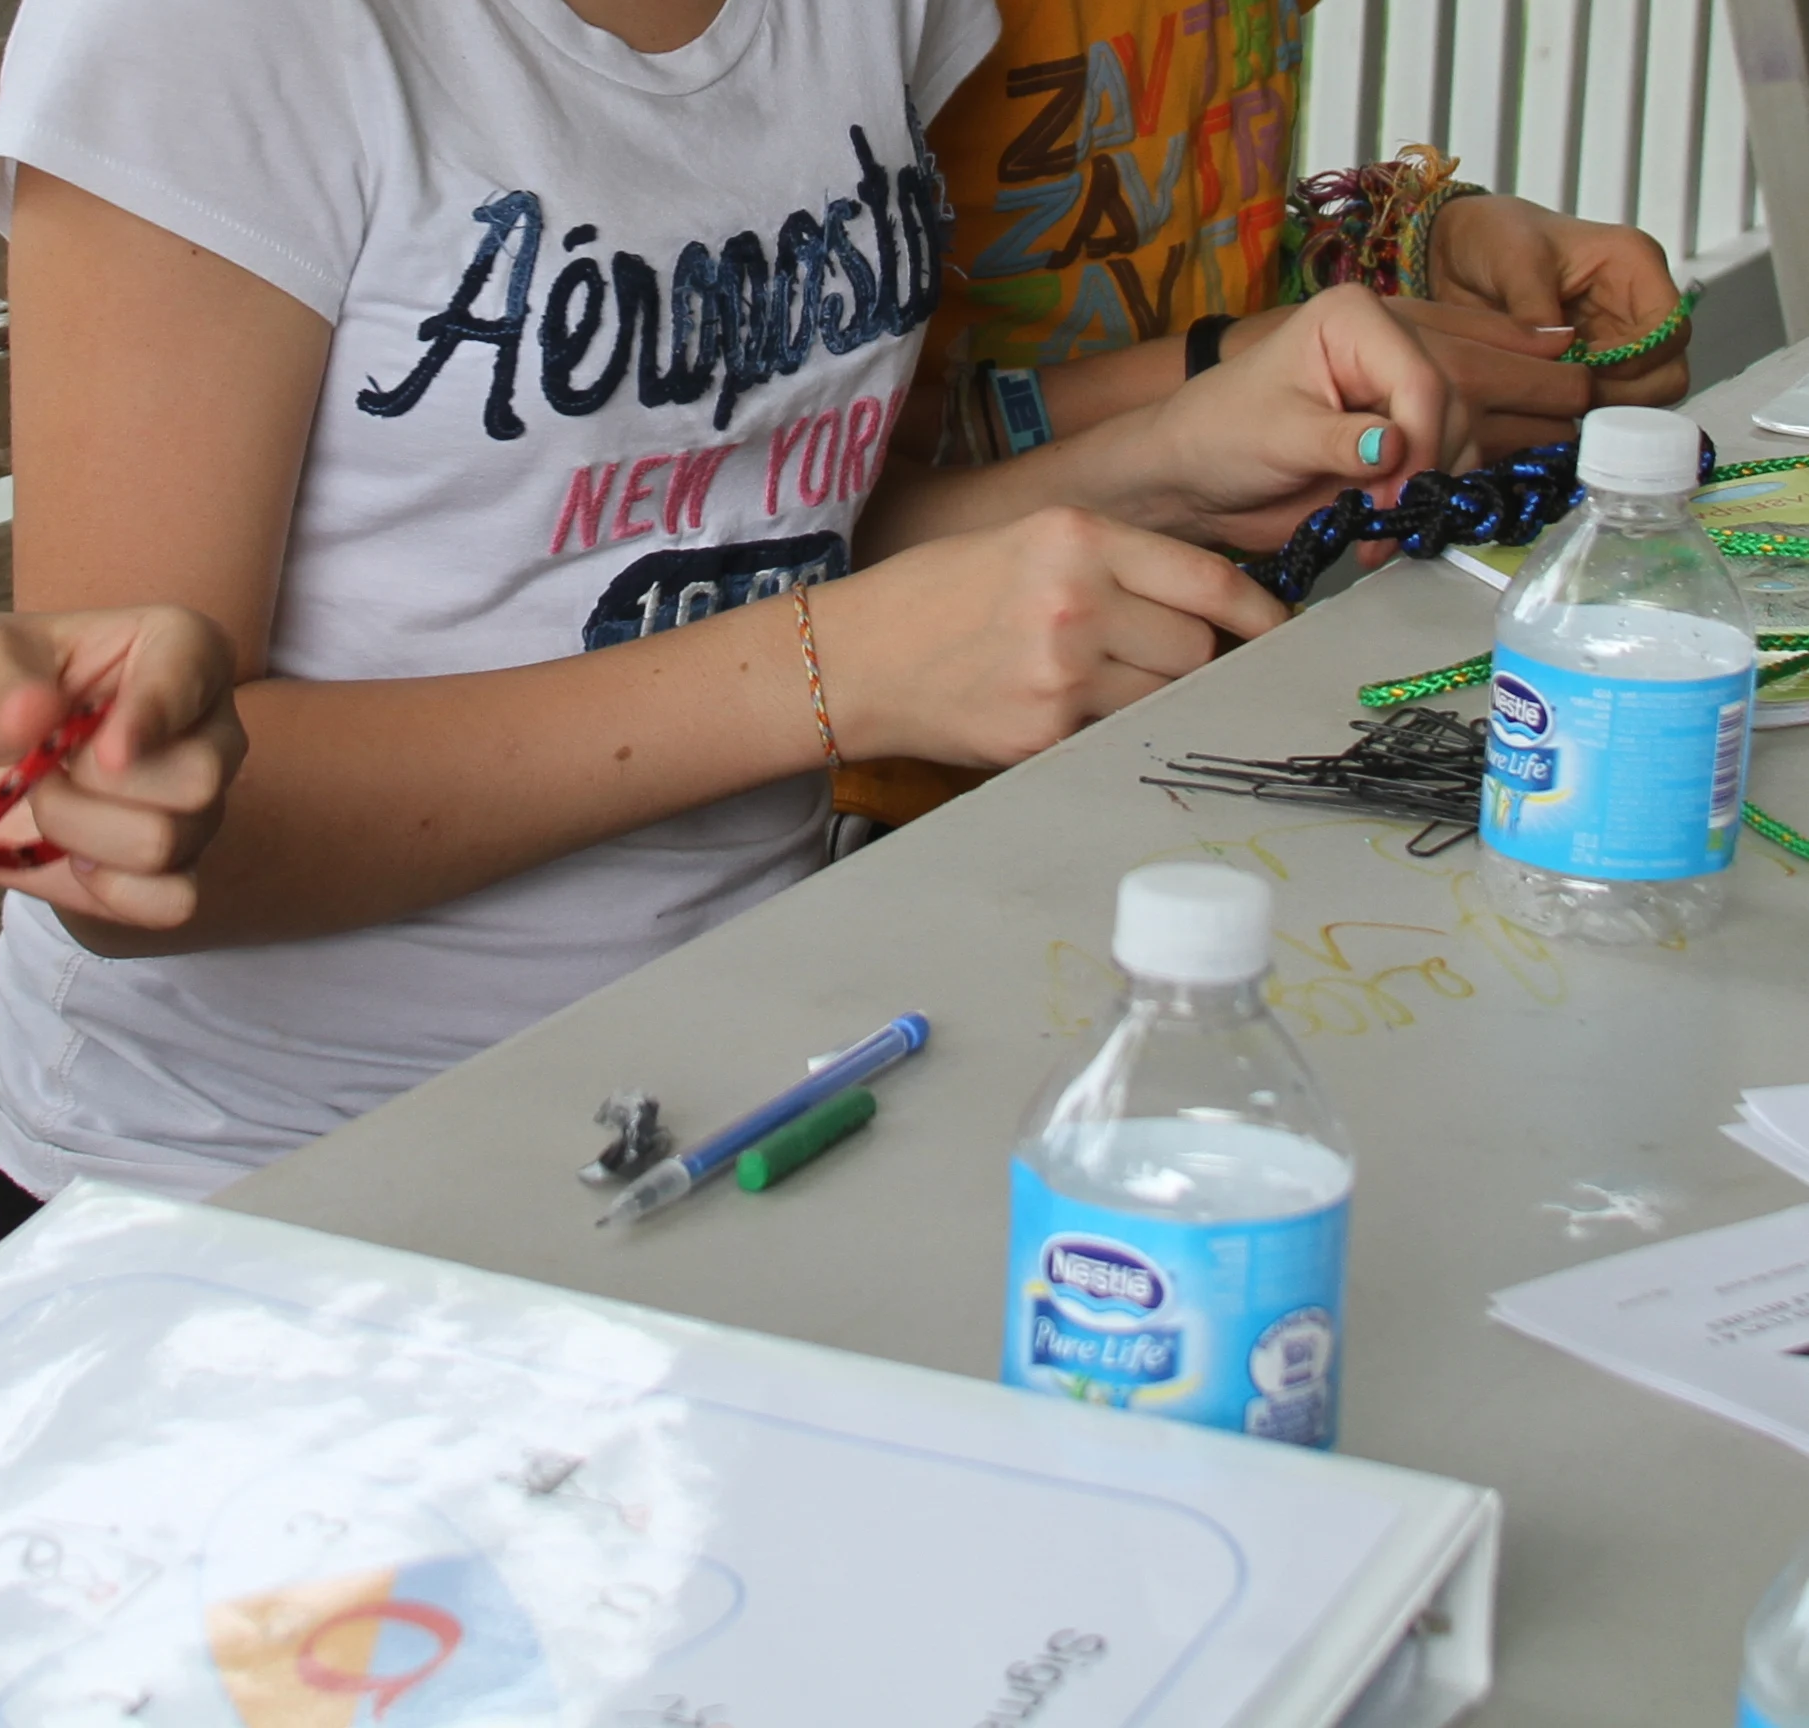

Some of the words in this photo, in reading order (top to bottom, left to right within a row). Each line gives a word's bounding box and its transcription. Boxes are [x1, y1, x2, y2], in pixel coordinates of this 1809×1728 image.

[972, 88, 1300, 278] ZAVTR
[548, 441, 741, 556] NEW
[1507, 751, 1549, 781] Life
[1033, 1314, 1098, 1362] Pure
[1100, 1332, 1171, 1371] Life
